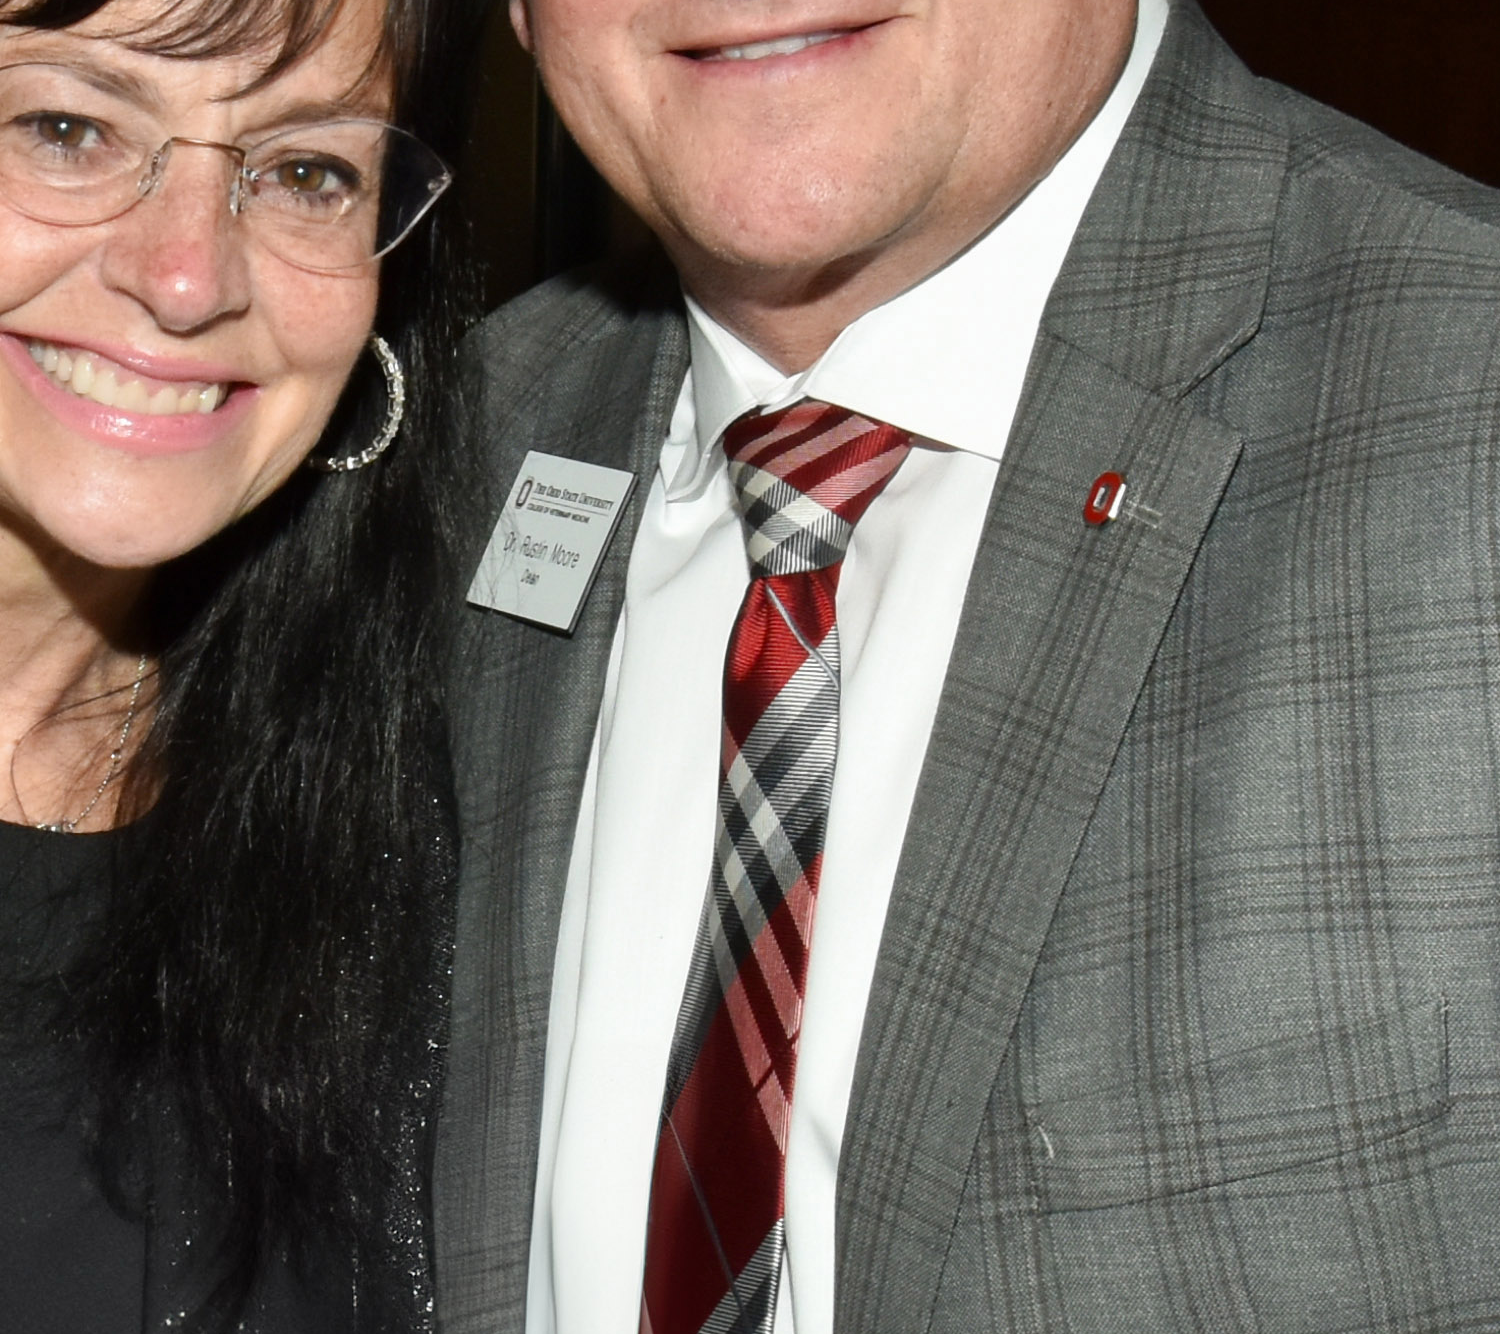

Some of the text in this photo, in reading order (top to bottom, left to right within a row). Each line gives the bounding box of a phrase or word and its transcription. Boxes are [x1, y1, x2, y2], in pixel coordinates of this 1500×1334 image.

[520, 535, 549, 561] Rustin
[550, 542, 580, 569] Moore
[520, 569, 540, 585] Dean
